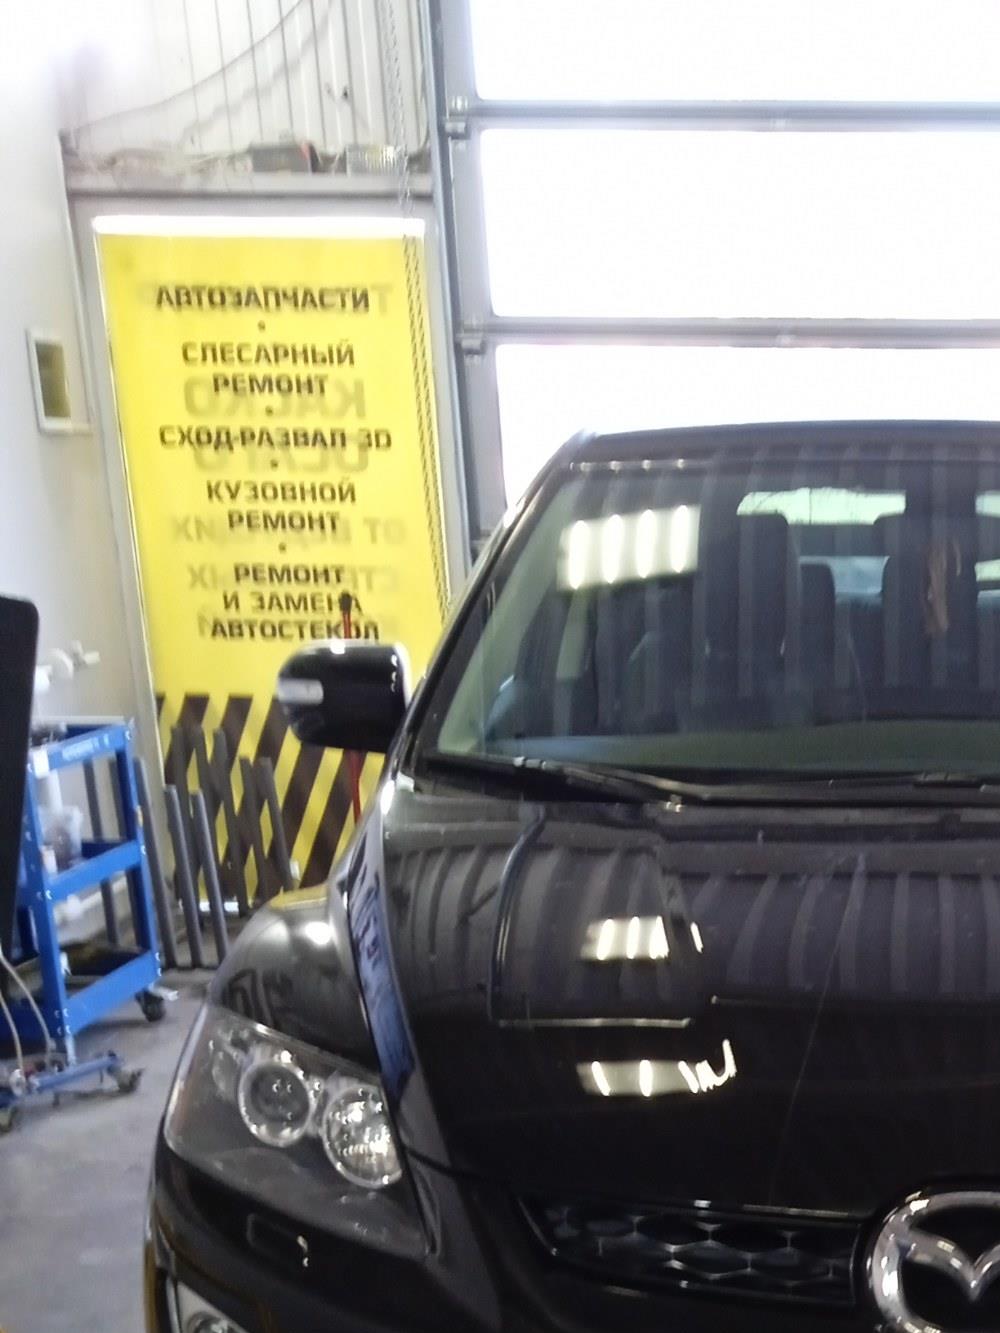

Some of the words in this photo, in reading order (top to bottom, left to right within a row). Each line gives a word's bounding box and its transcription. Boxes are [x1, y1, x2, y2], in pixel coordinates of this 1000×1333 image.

[156, 287, 371, 312] АВТОЗАПЧАСТИ
[181, 338, 356, 366] СЛЕСАРНЫЙ
[212, 373, 330, 396] РЕМОНТ
[158, 426, 348, 453] СХОД-РАЗВАЛ
[354, 428, 393, 450] 3D
[206, 477, 357, 503] КУЗОВНОЙ
[227, 510, 341, 533] РЕМОНТ
[234, 563, 346, 586] РЕМОНТ
[223, 592, 241, 612] И
